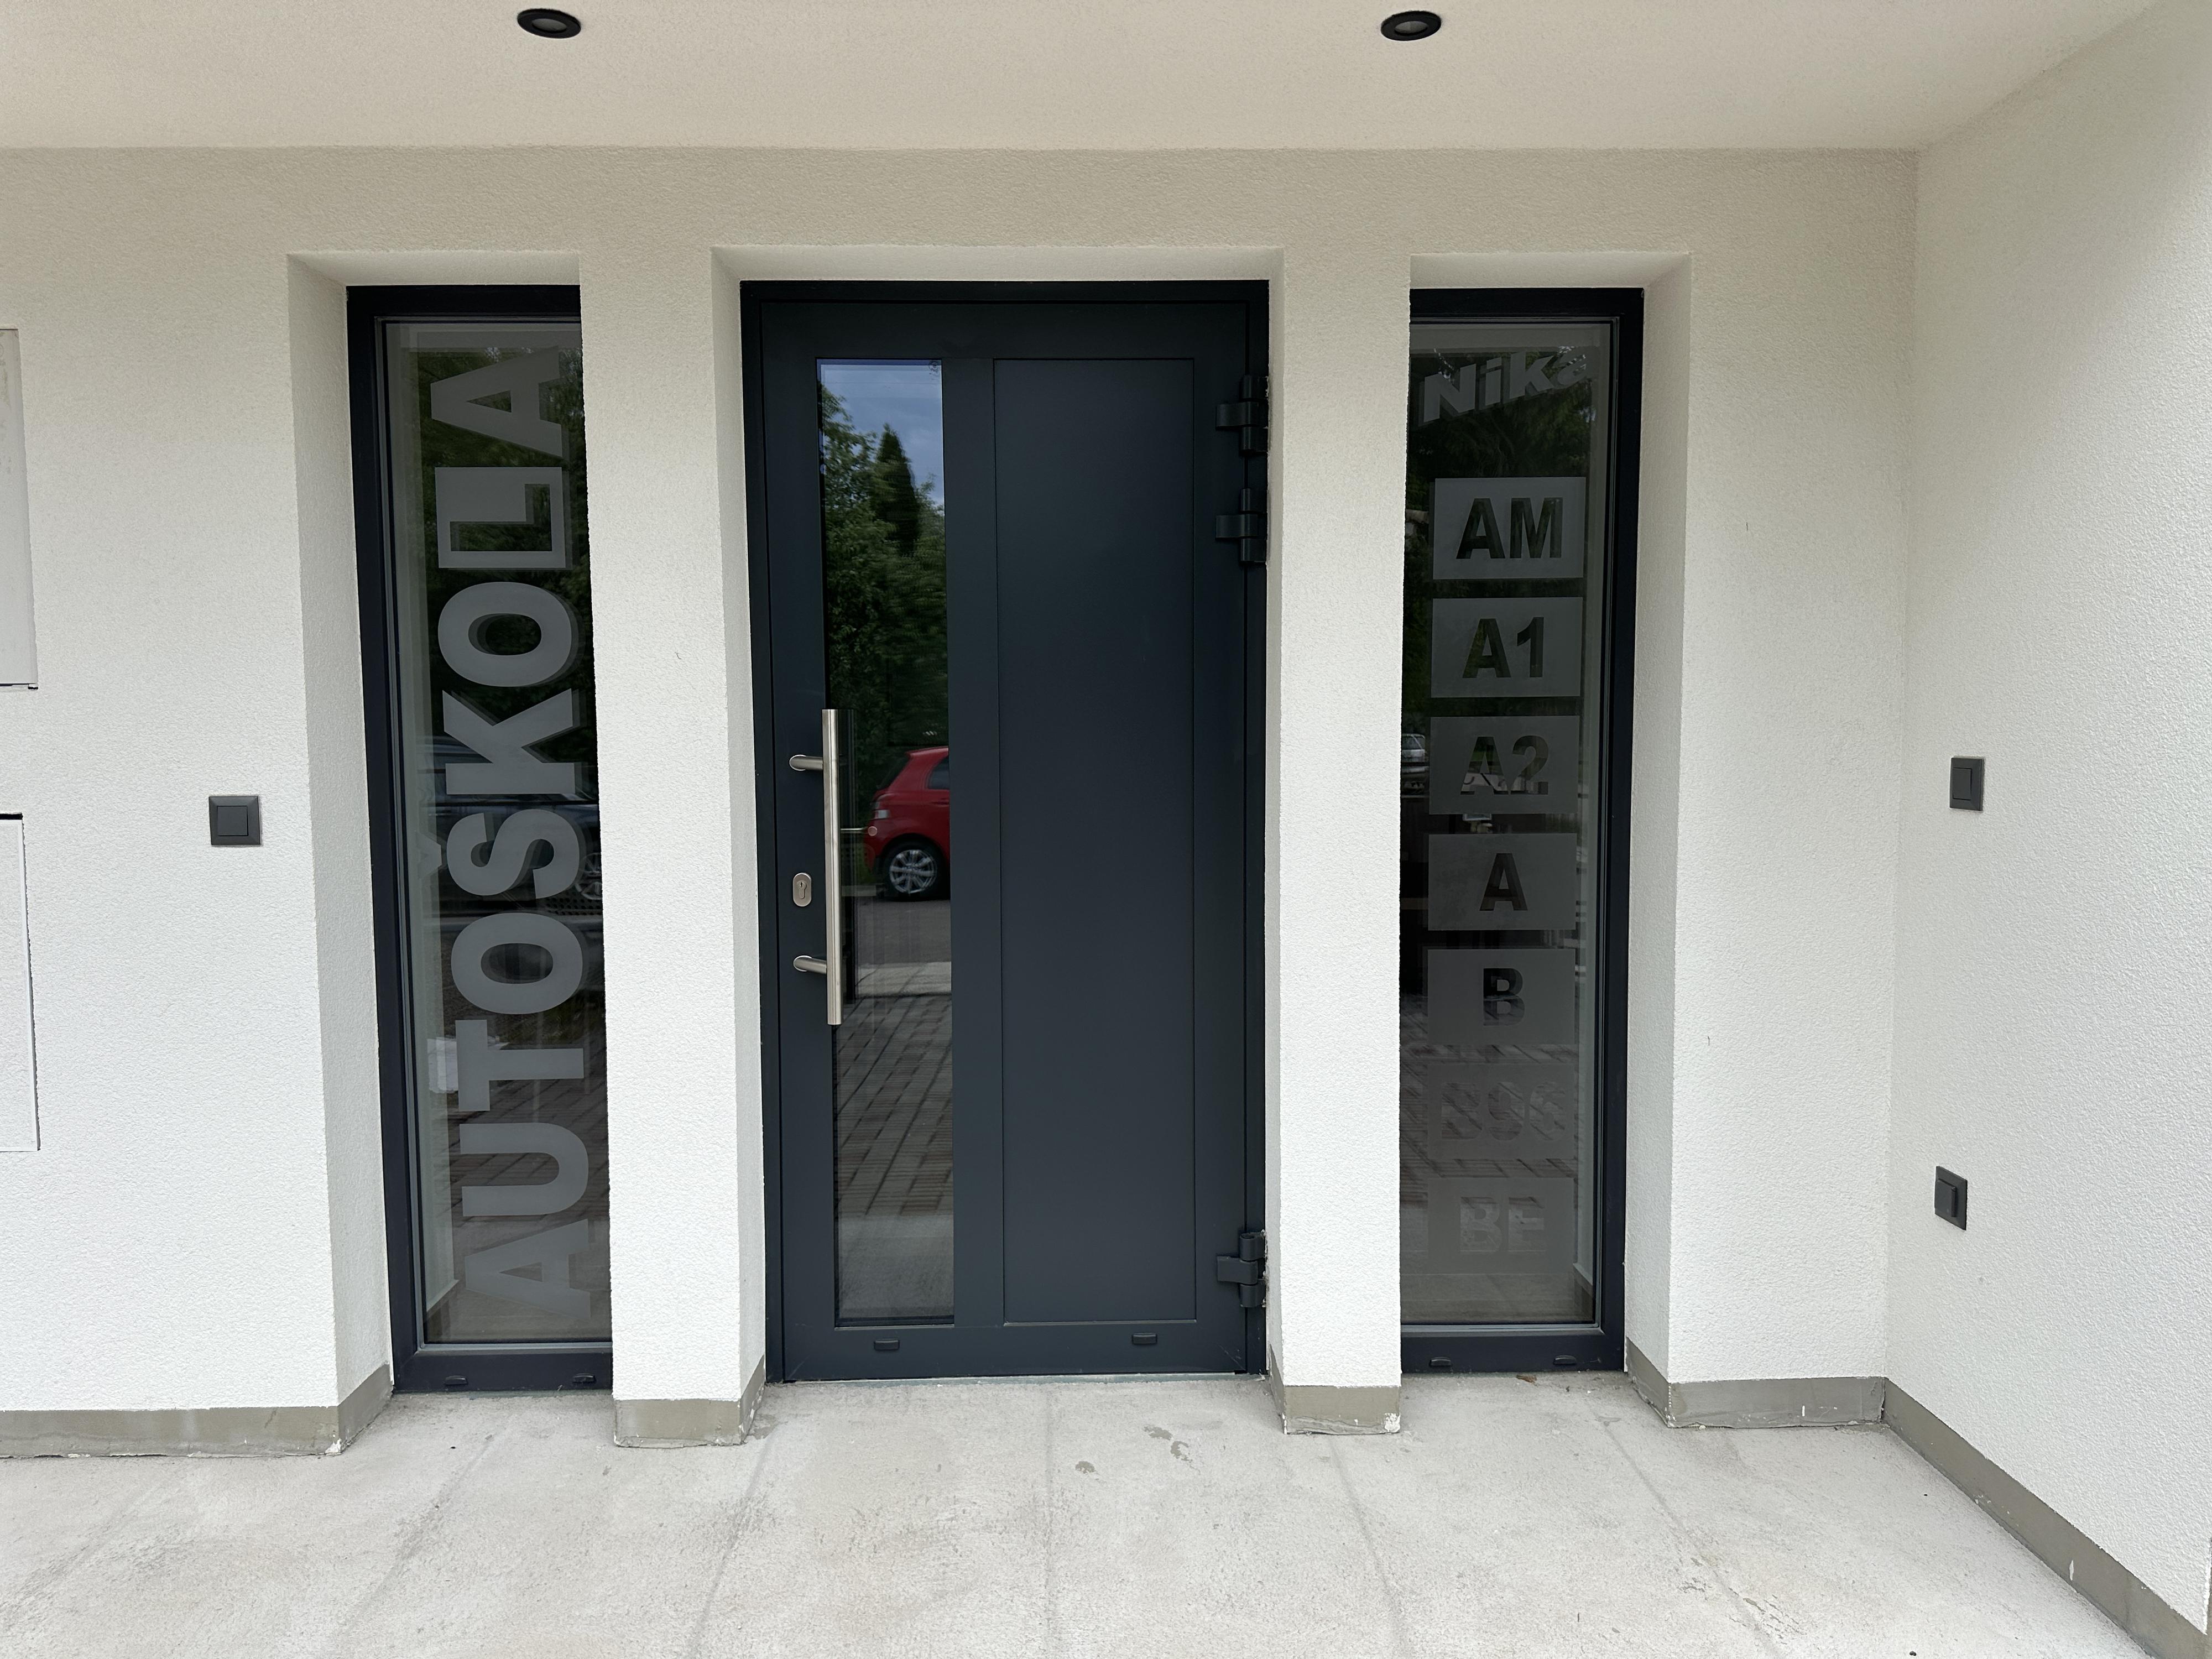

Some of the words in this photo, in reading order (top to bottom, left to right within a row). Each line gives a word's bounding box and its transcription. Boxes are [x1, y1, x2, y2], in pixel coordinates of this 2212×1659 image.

[1423, 347, 1595, 423] Nika
[1456, 497, 1563, 559] AM
[1463, 617, 1544, 679] A1
[1460, 735, 1549, 795] A2
[416, 346, 591, 1319] AUTOŠKOLA
[1479, 853, 1528, 911] A
[1483, 968, 1525, 1026] B
[1441, 1081, 1566, 1141] B96
[1460, 1197, 1547, 1253] BE
